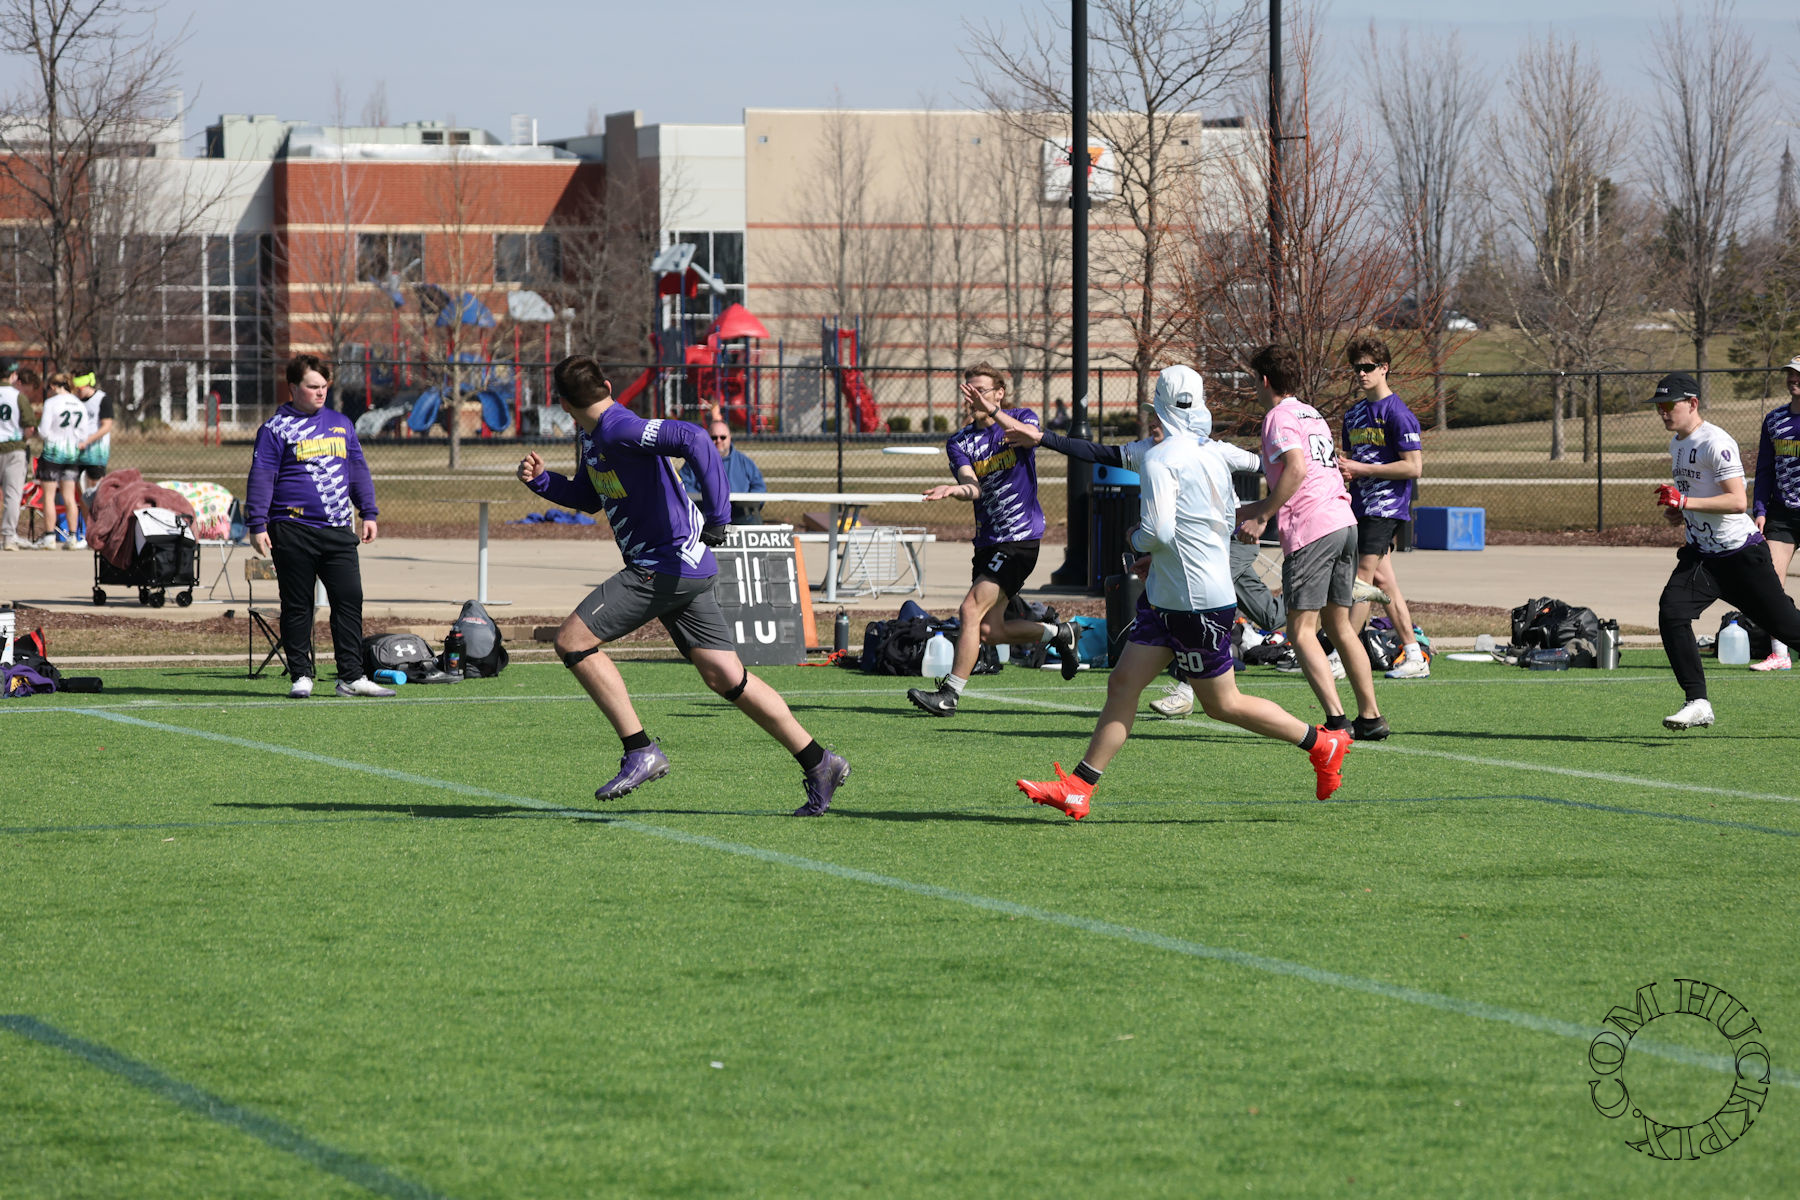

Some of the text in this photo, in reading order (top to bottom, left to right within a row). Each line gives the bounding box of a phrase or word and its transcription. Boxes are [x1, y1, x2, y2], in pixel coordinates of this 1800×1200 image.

[60, 410, 83, 428] 27
[747, 532, 791, 547] DARK
[988, 551, 1008, 572] 5
[1175, 651, 1204, 672] 20
[1064, 793, 1085, 805] NIKE
